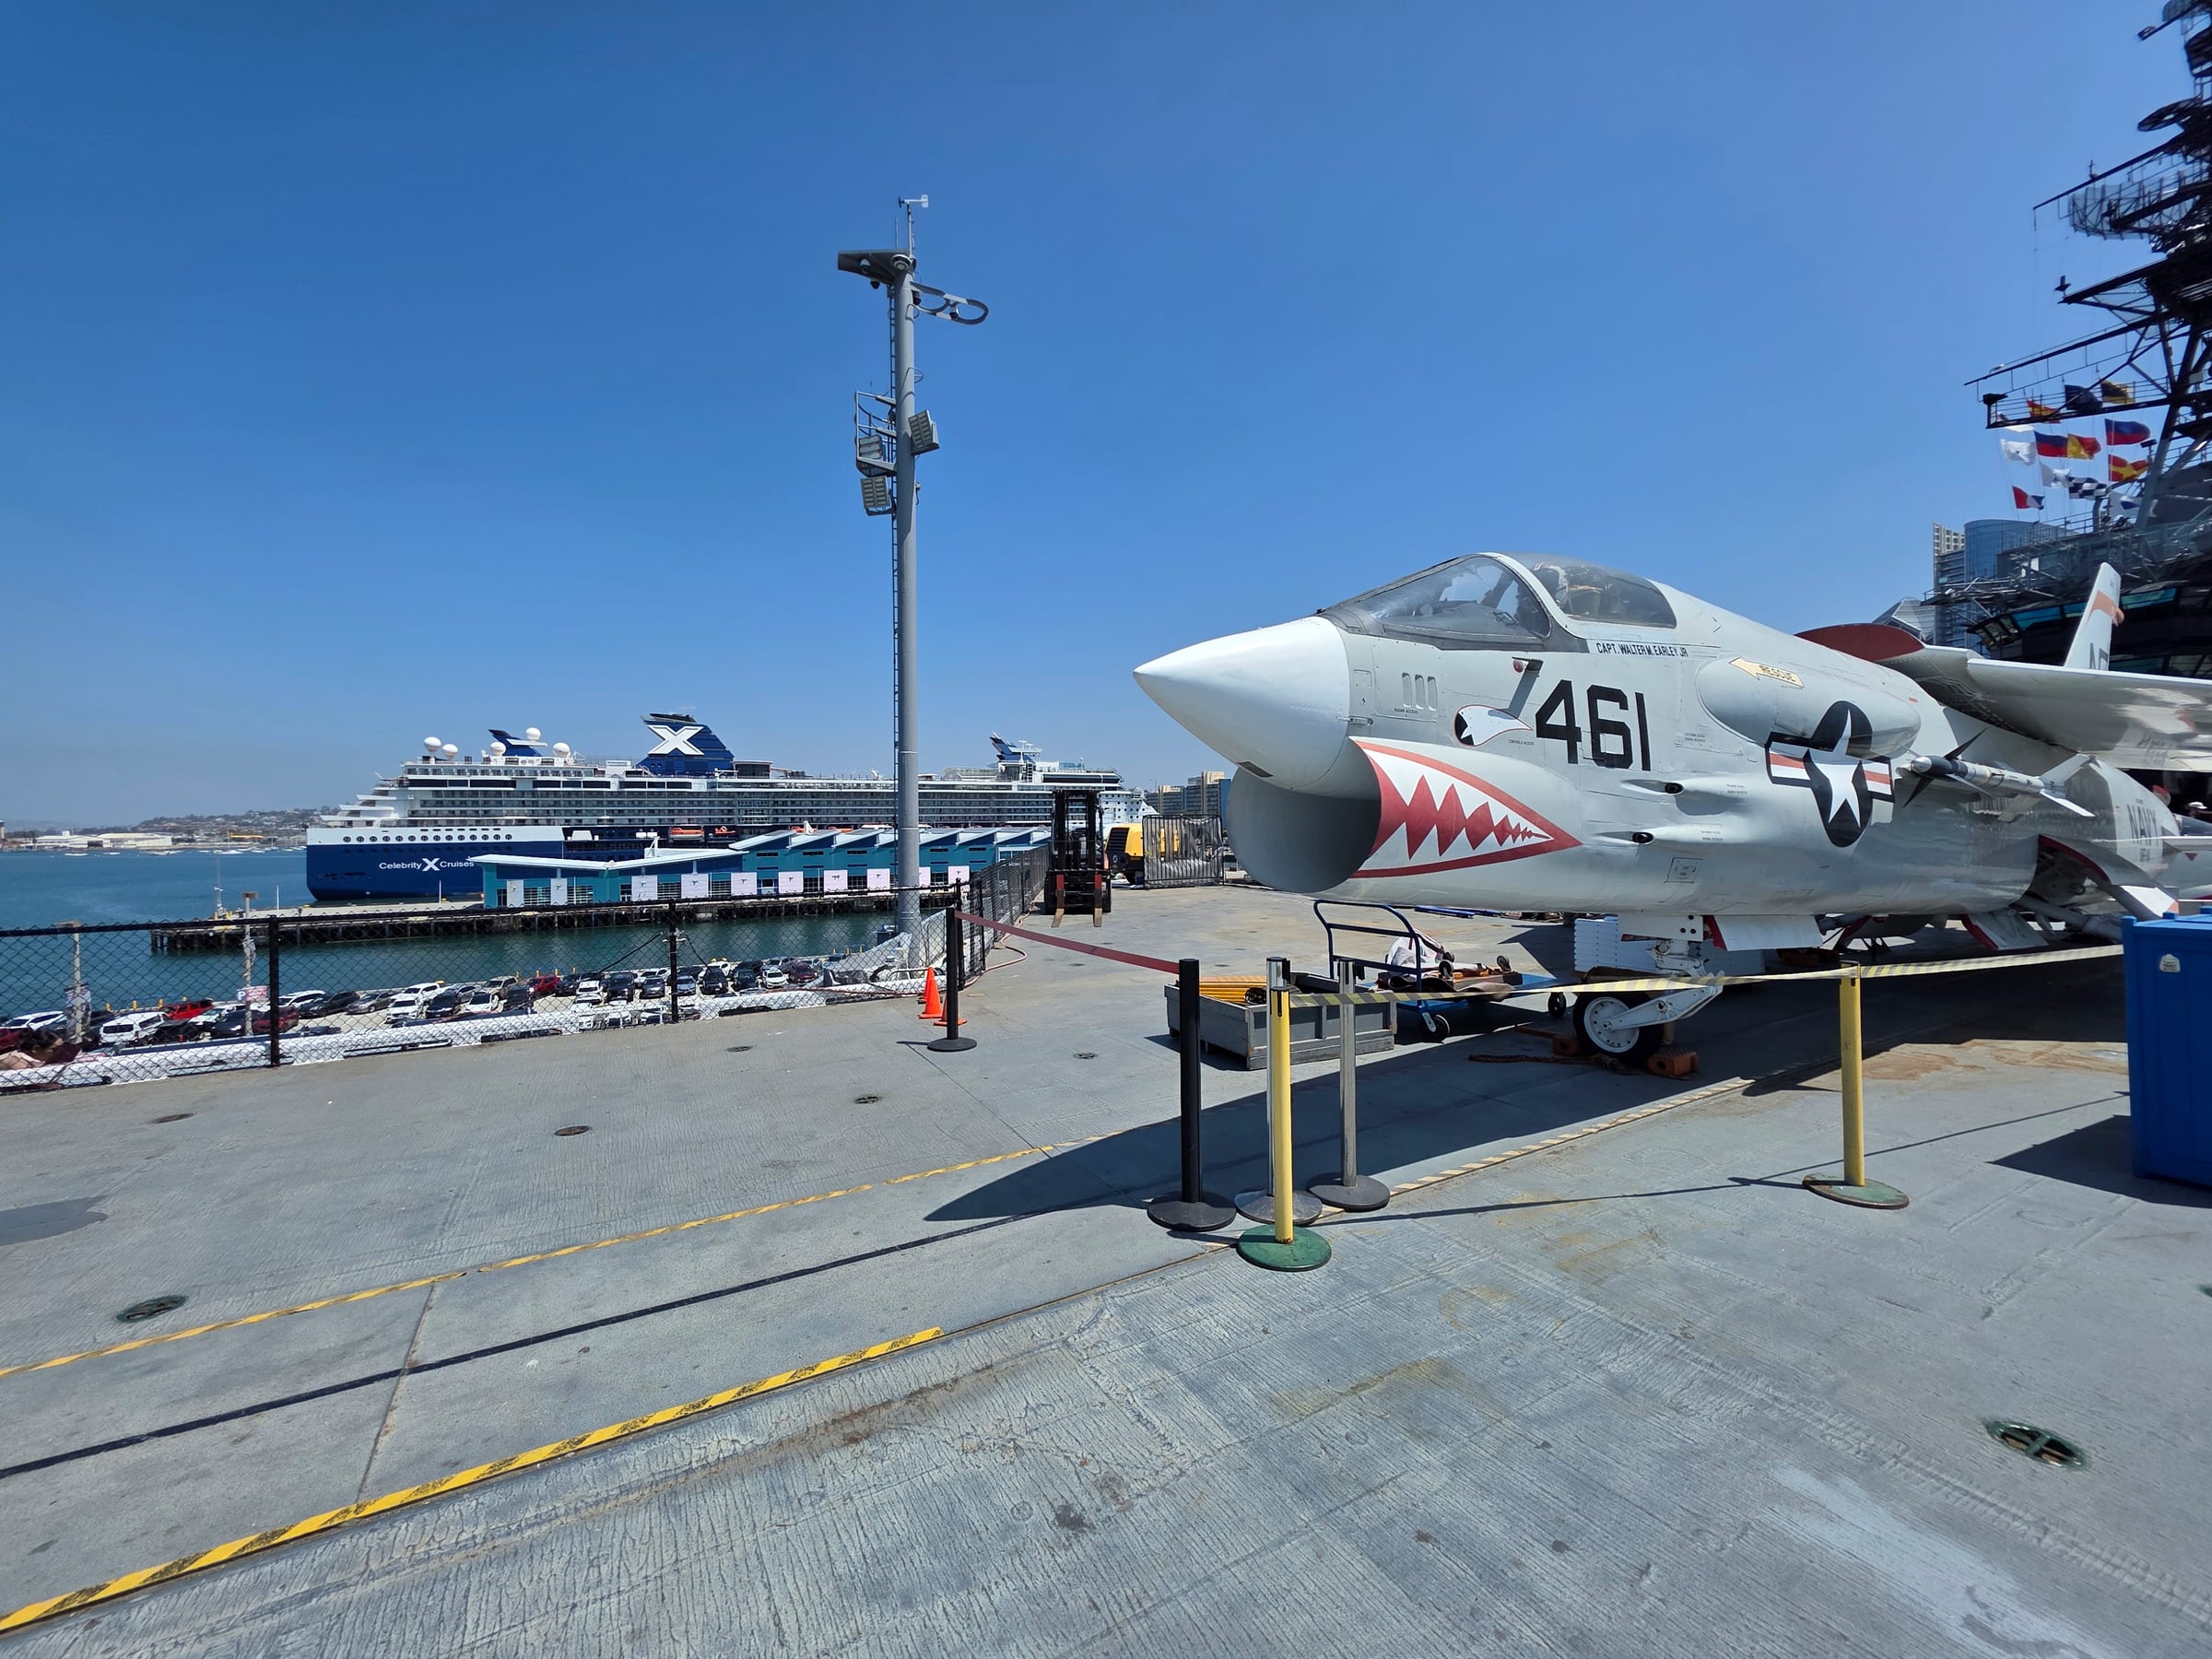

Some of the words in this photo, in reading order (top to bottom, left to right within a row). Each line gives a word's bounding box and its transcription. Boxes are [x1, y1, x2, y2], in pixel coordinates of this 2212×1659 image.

[1596, 642, 1619, 654] CAPT.
[1618, 643, 1646, 655] WALTER
[1653, 645, 1678, 657] EARLEY
[1680, 646, 1689, 657] JR
[1759, 665, 1795, 682] RESCUE
[1535, 679, 1651, 771] 461
[648, 724, 705, 756] X
[2126, 803, 2159, 847] NAVY
[379, 862, 422, 870] Celebrity
[421, 857, 441, 872] X
[440, 860, 475, 868] Cruises
